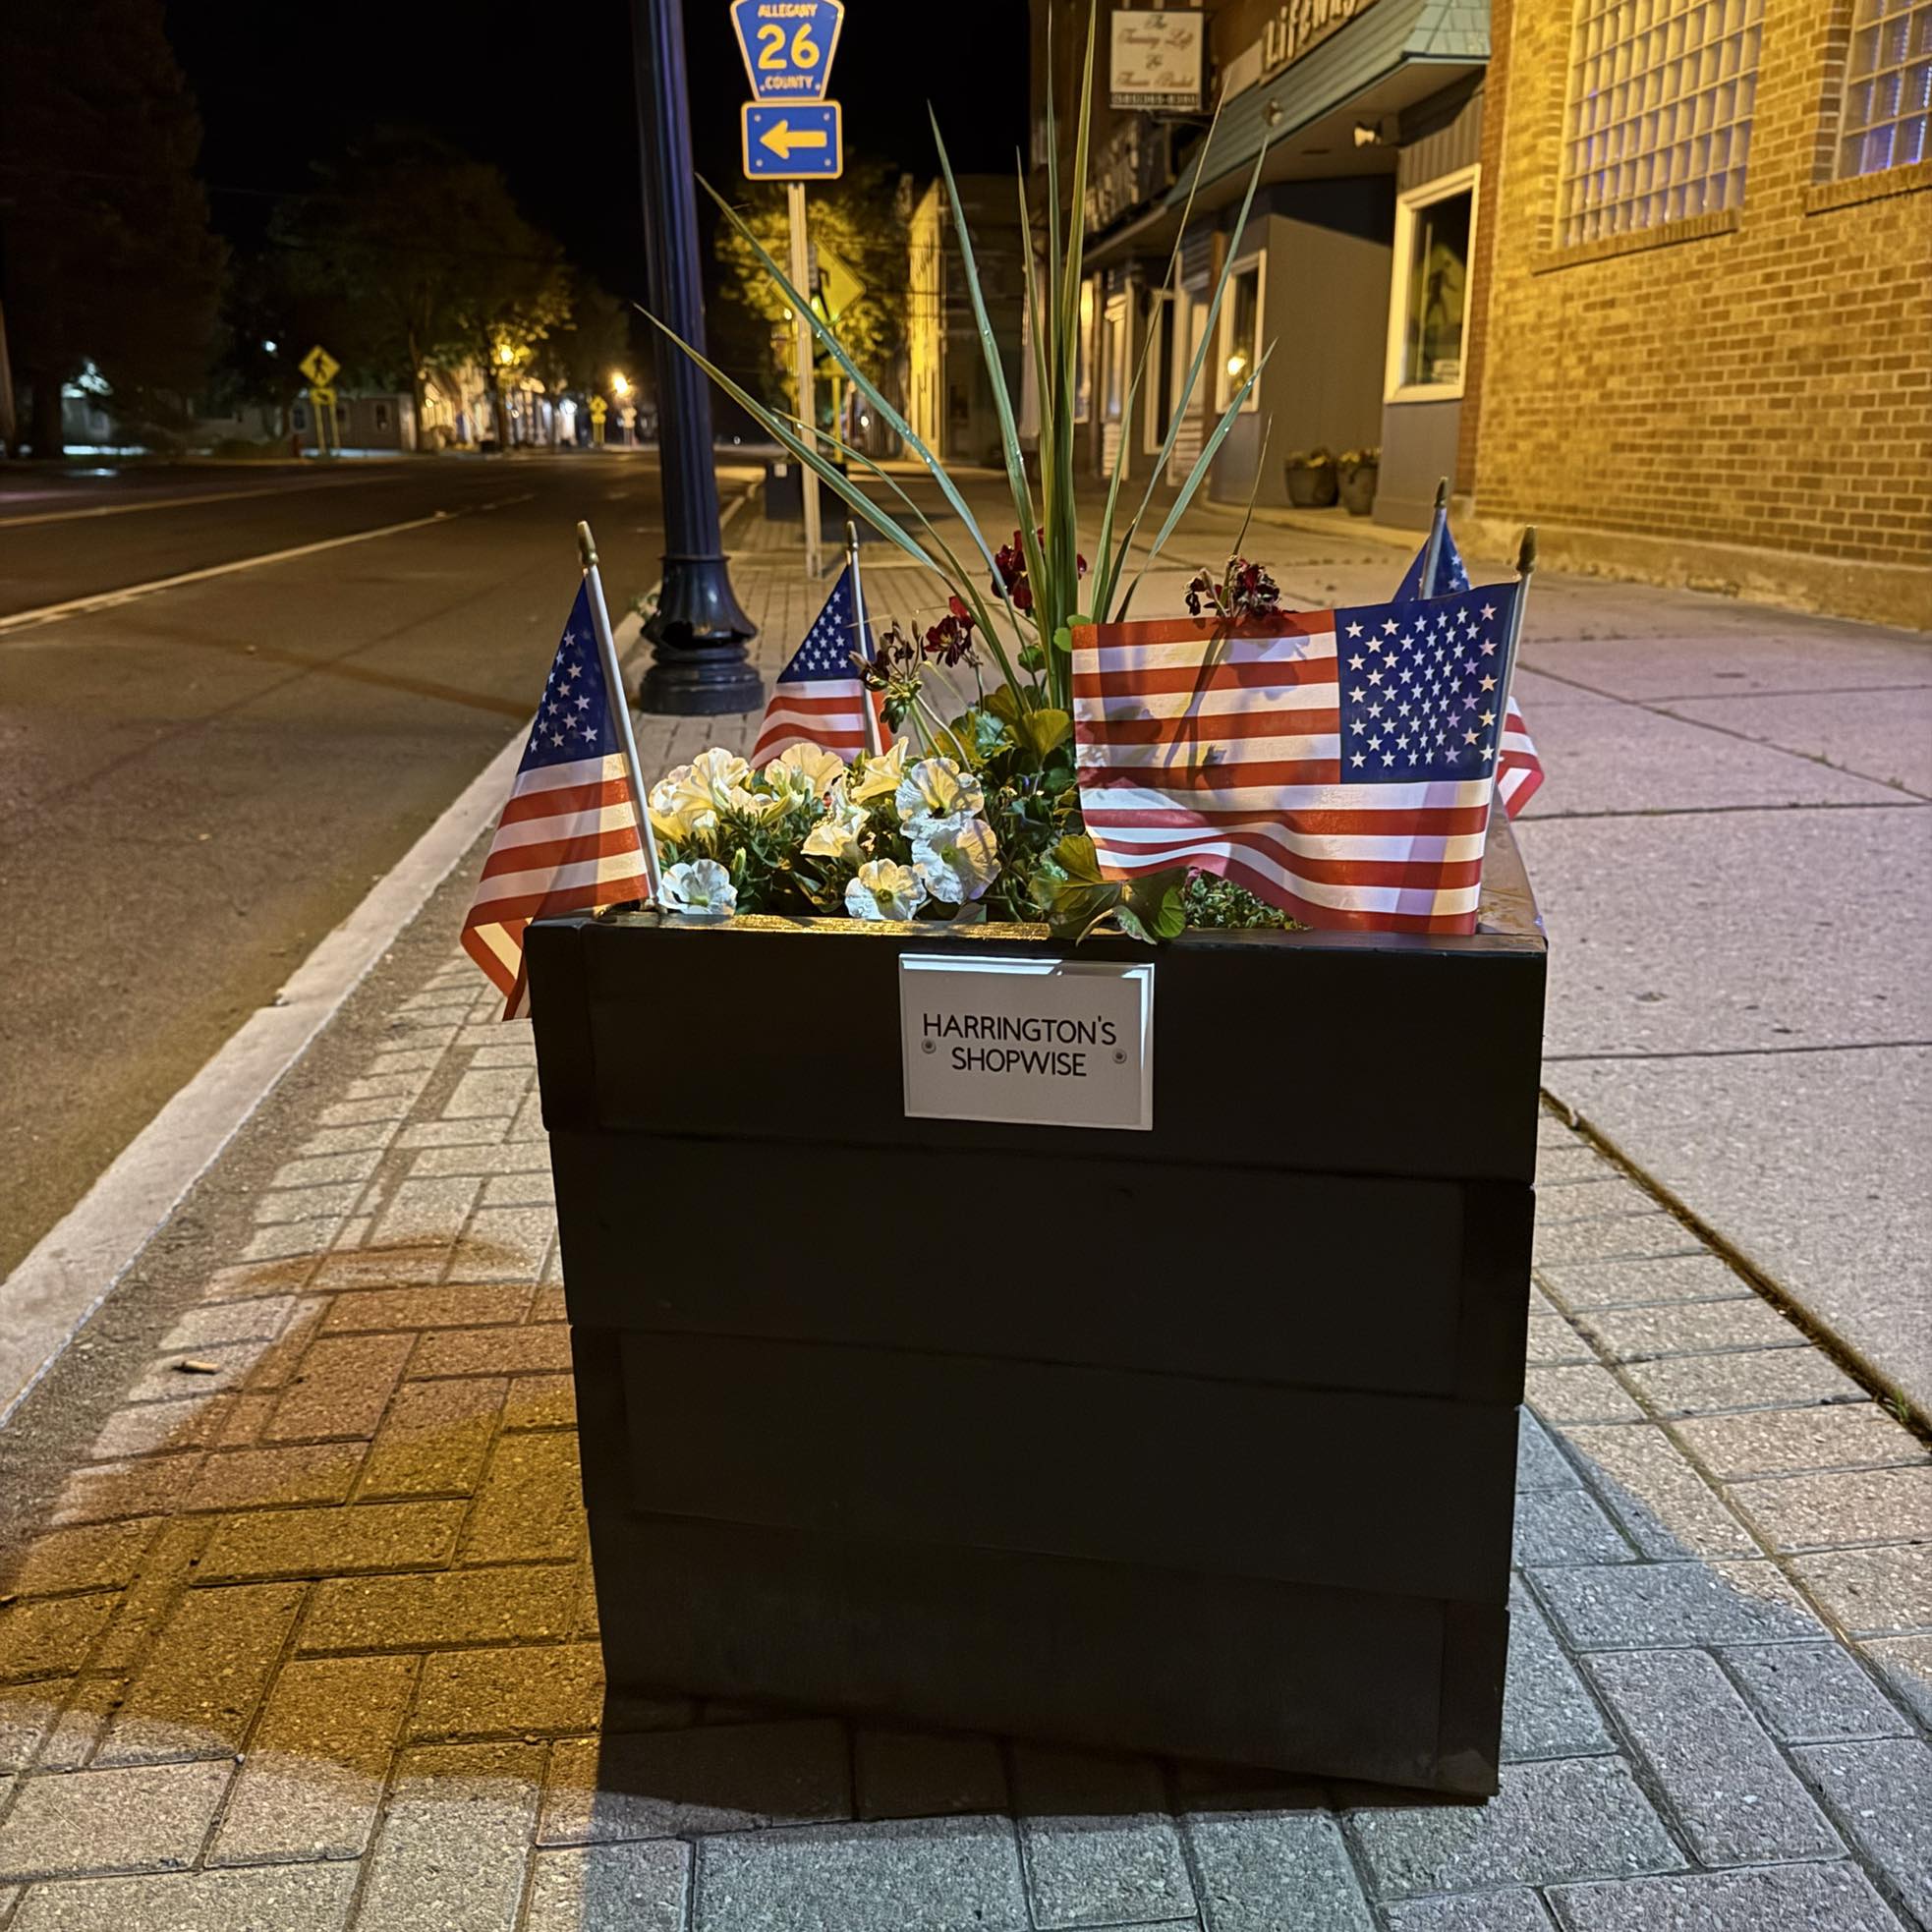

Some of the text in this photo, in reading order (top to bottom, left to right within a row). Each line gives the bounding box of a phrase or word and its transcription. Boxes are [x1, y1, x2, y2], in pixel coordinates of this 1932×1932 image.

[758, 4, 818, 18] ALLEGANY
[757, 24, 820, 69] 26
[765, 76, 814, 89] COUNTY
[923, 1013, 1116, 1045] HARRINGTON'S
[951, 1047, 1087, 1076] SHOPWISE
